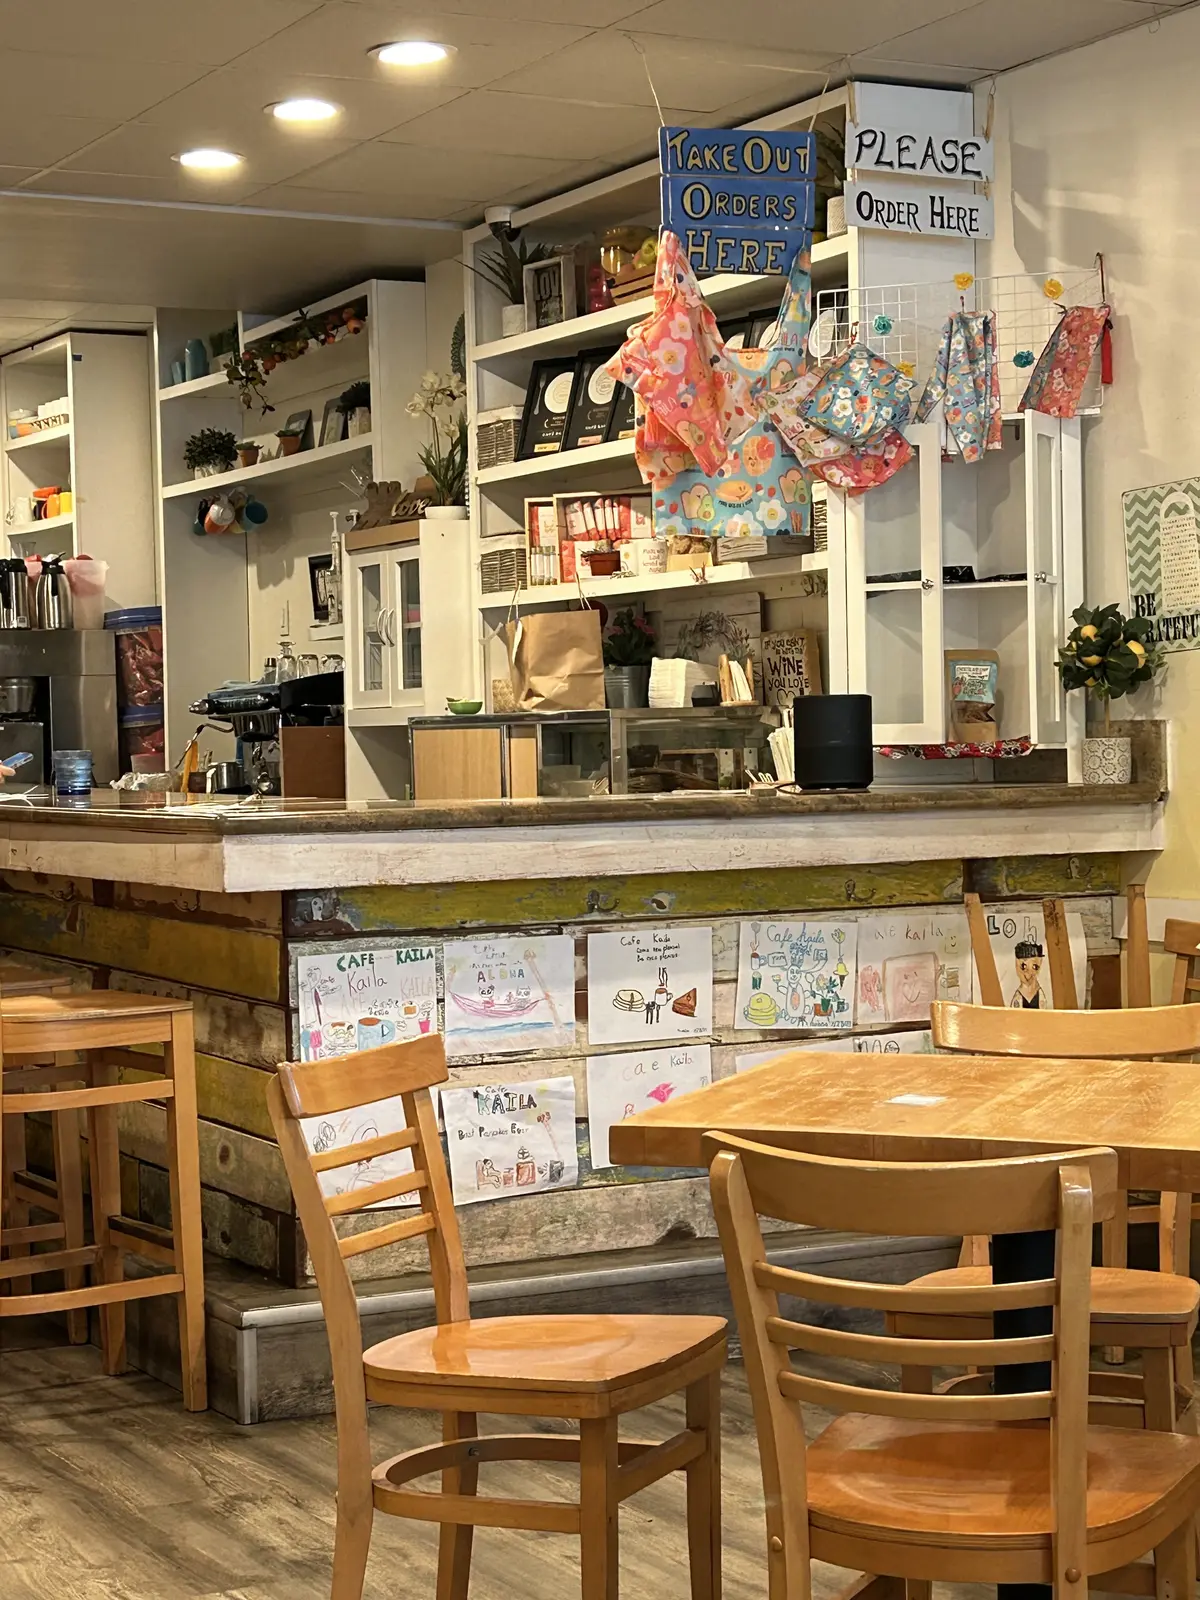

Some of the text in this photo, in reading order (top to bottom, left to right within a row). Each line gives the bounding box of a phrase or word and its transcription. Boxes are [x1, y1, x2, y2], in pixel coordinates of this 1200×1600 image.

[669, 131, 810, 174] TAKE OUT
[855, 128, 984, 180] PLEASE
[682, 182, 797, 221] ORDERS
[856, 190, 980, 237] ORDER HERE
[686, 229, 786, 275] HERE
[1134, 592, 1157, 618] BE
[1145, 614, 1200, 643] RATEFU
[336, 948, 434, 972] CAFE KAILA
[347, 963, 388, 997] Kaila
[476, 1091, 538, 1116] KAILA
